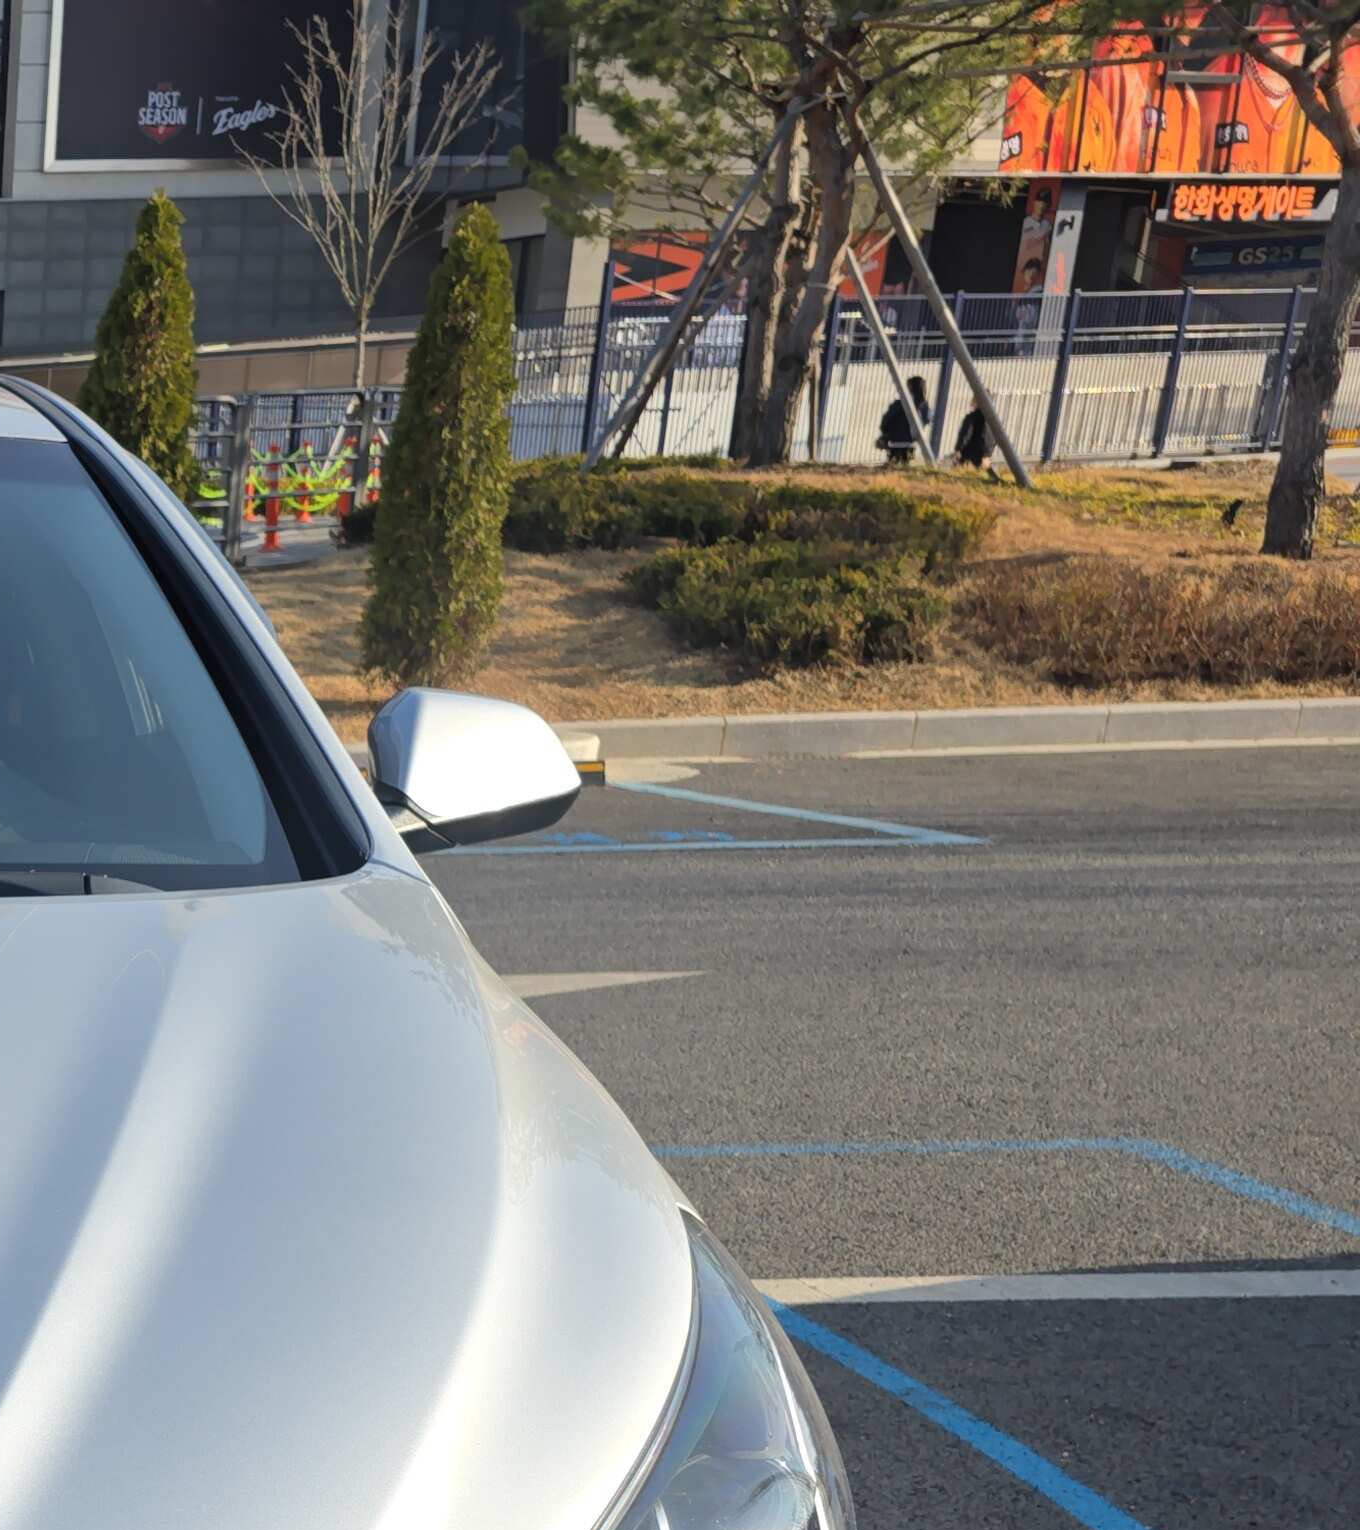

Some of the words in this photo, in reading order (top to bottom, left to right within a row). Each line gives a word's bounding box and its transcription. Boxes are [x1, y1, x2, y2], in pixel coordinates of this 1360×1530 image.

[148, 91, 180, 107] POST
[138, 107, 187, 126] SEASON
[212, 99, 276, 135] Eagles
[1173, 184, 1316, 222] 한화생명게이트
[1238, 246, 1294, 265] GS25
